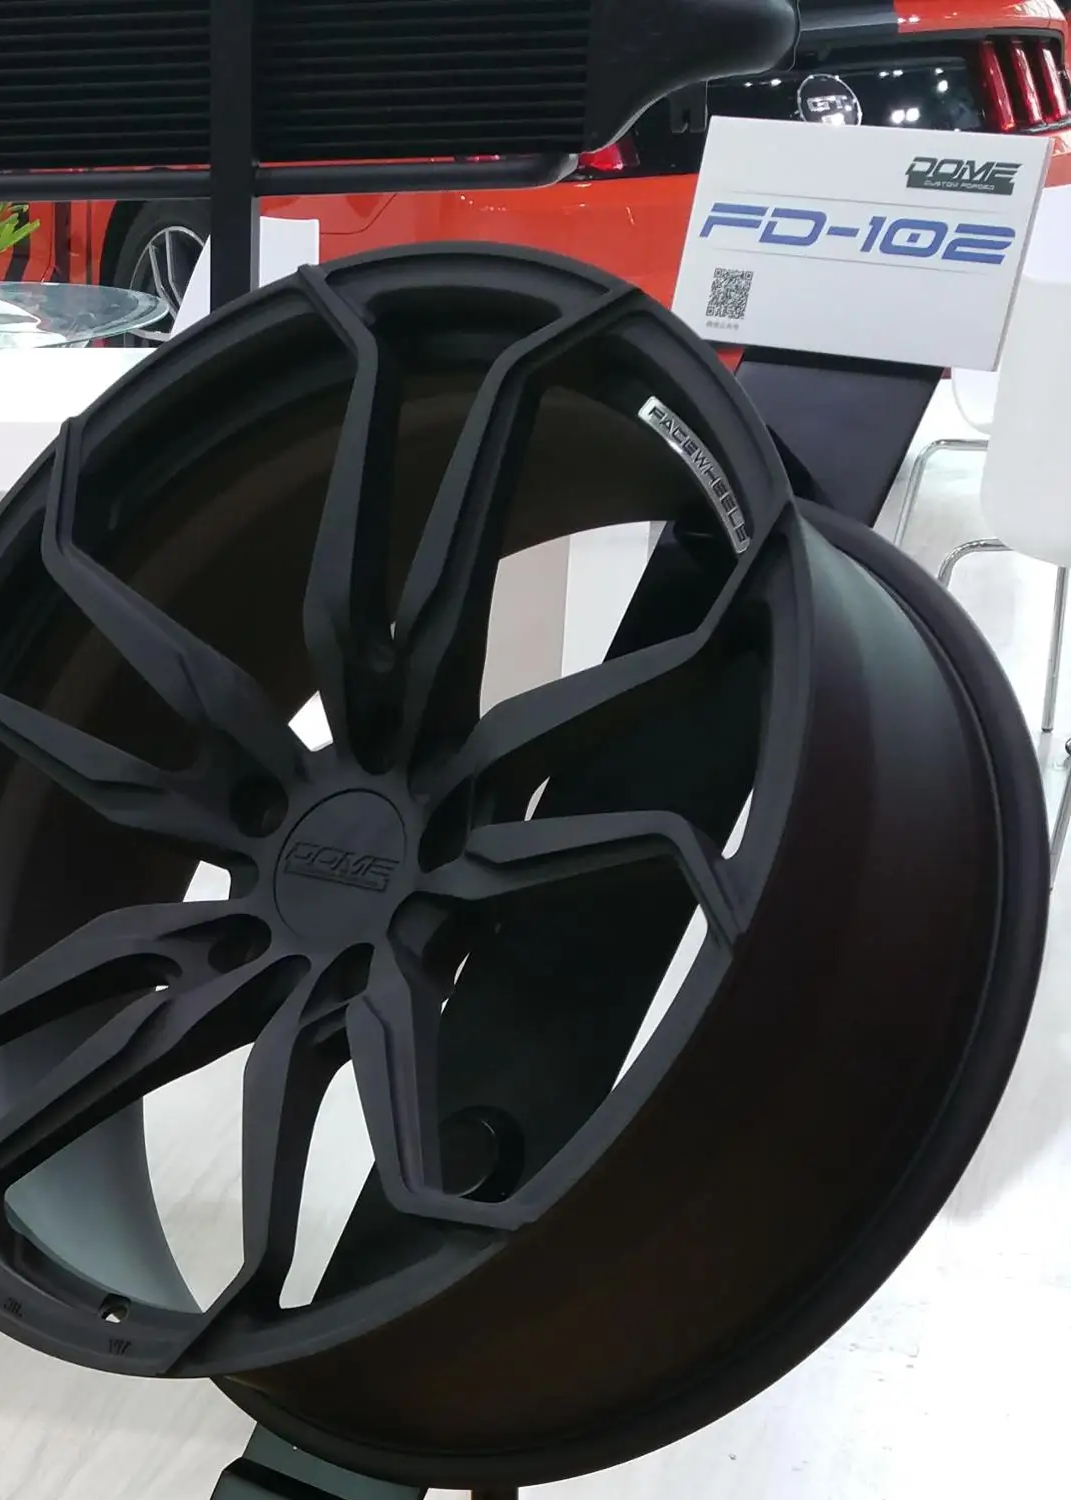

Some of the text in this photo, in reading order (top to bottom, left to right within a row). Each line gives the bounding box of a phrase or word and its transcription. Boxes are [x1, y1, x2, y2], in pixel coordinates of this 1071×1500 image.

[905, 157, 1023, 183] DOME
[699, 202, 1016, 265] FD-102
[648, 405, 748, 545] FACEWHEELS
[286, 842, 400, 877] DOME
